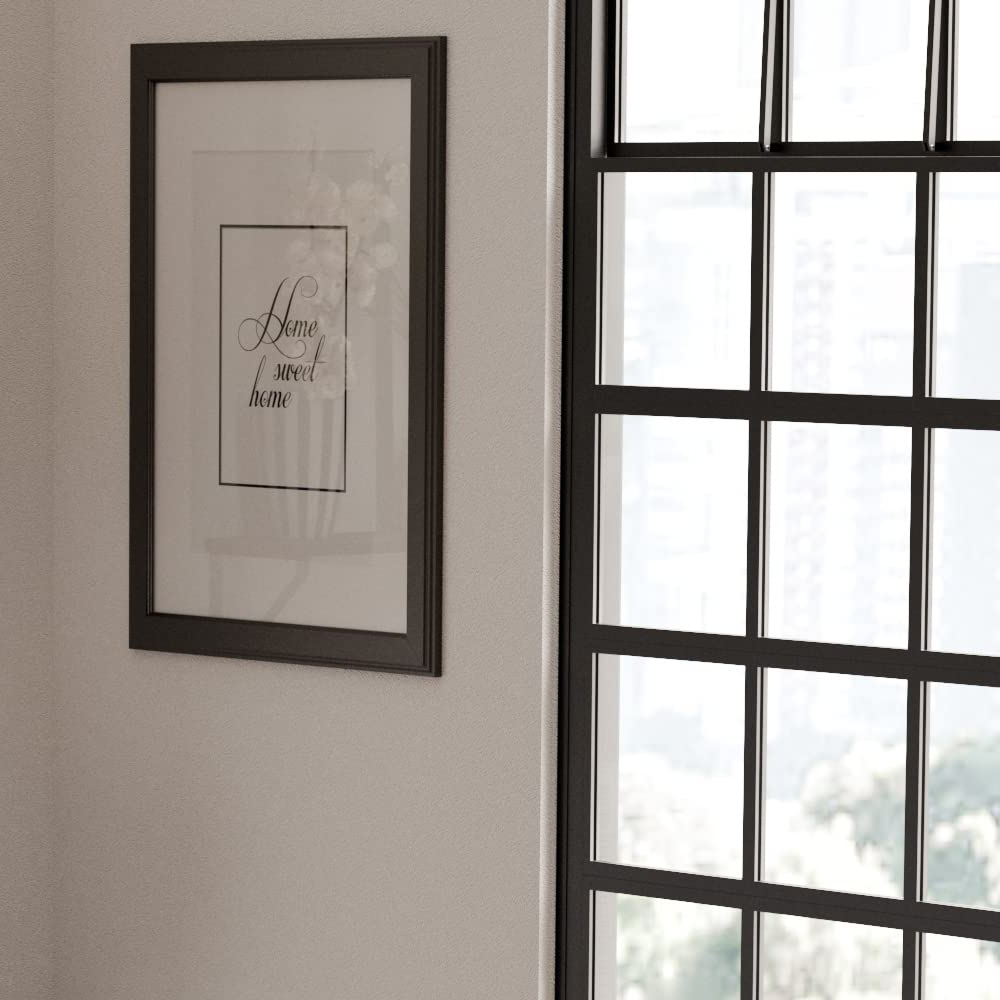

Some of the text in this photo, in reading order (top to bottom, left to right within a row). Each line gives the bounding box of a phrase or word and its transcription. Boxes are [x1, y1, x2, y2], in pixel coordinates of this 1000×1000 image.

[238, 275, 318, 359] Home
[249, 354, 292, 408] home
[273, 335, 328, 382] sweet
